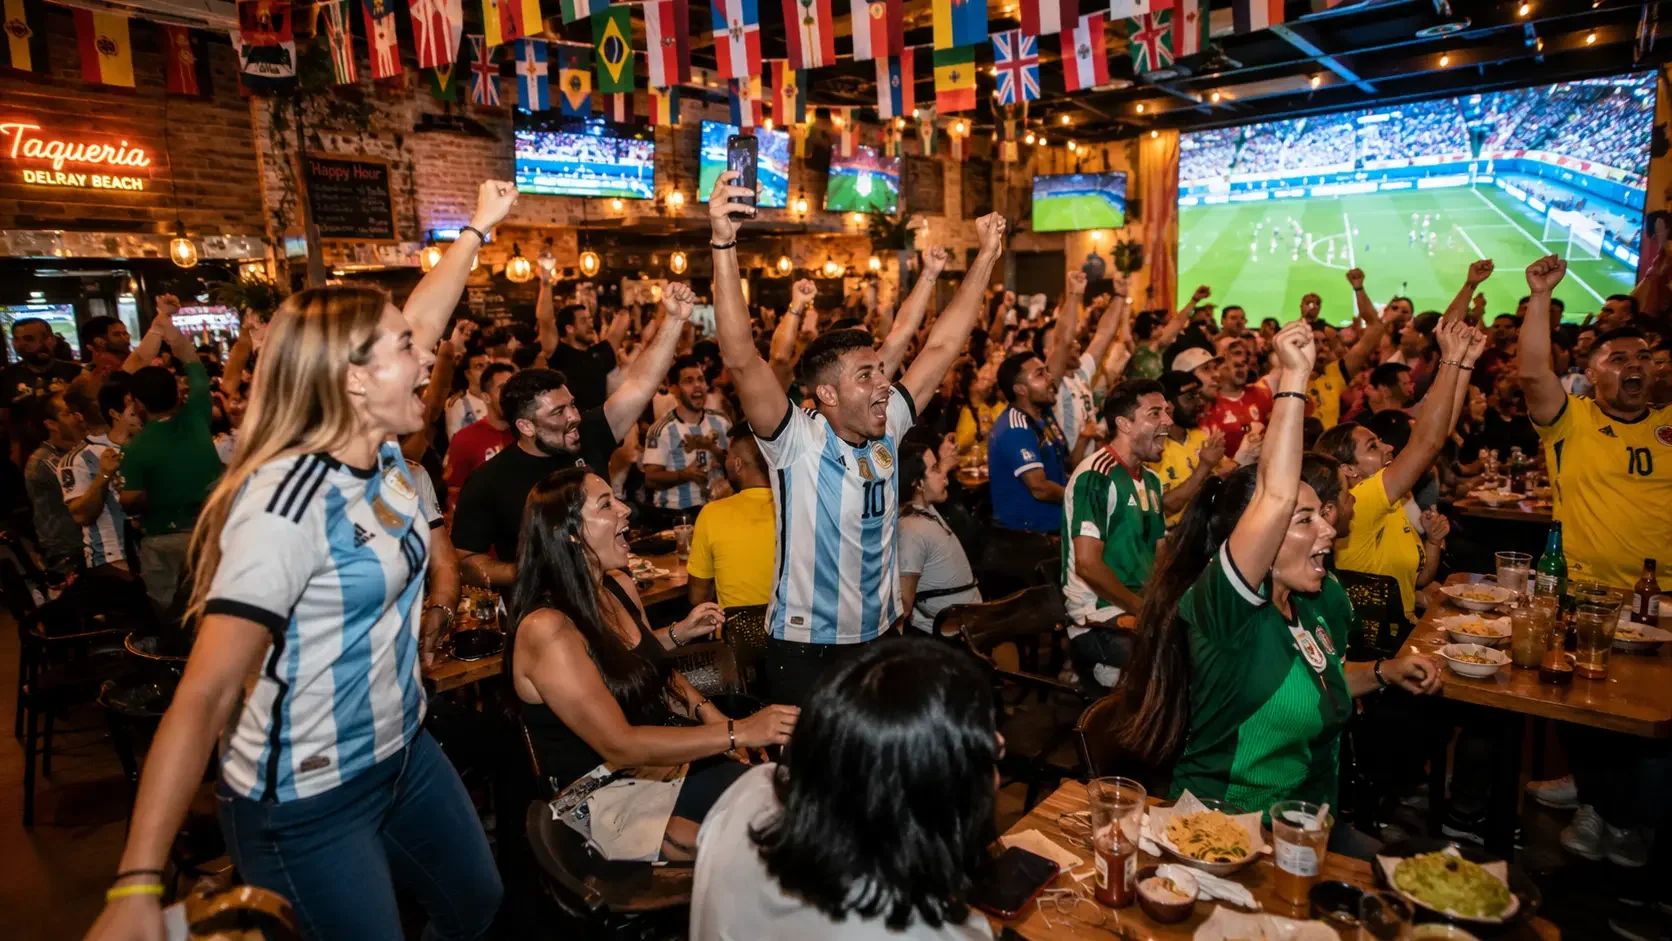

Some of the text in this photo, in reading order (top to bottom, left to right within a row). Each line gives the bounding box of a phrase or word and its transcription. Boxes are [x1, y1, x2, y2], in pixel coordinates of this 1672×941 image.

[0, 123, 150, 171] Taqueria
[23, 170, 144, 191] DELRAY BEACH
[312, 162, 382, 181] Happy Hour
[1626, 446, 1653, 476] 10
[861, 479, 886, 519] 10
